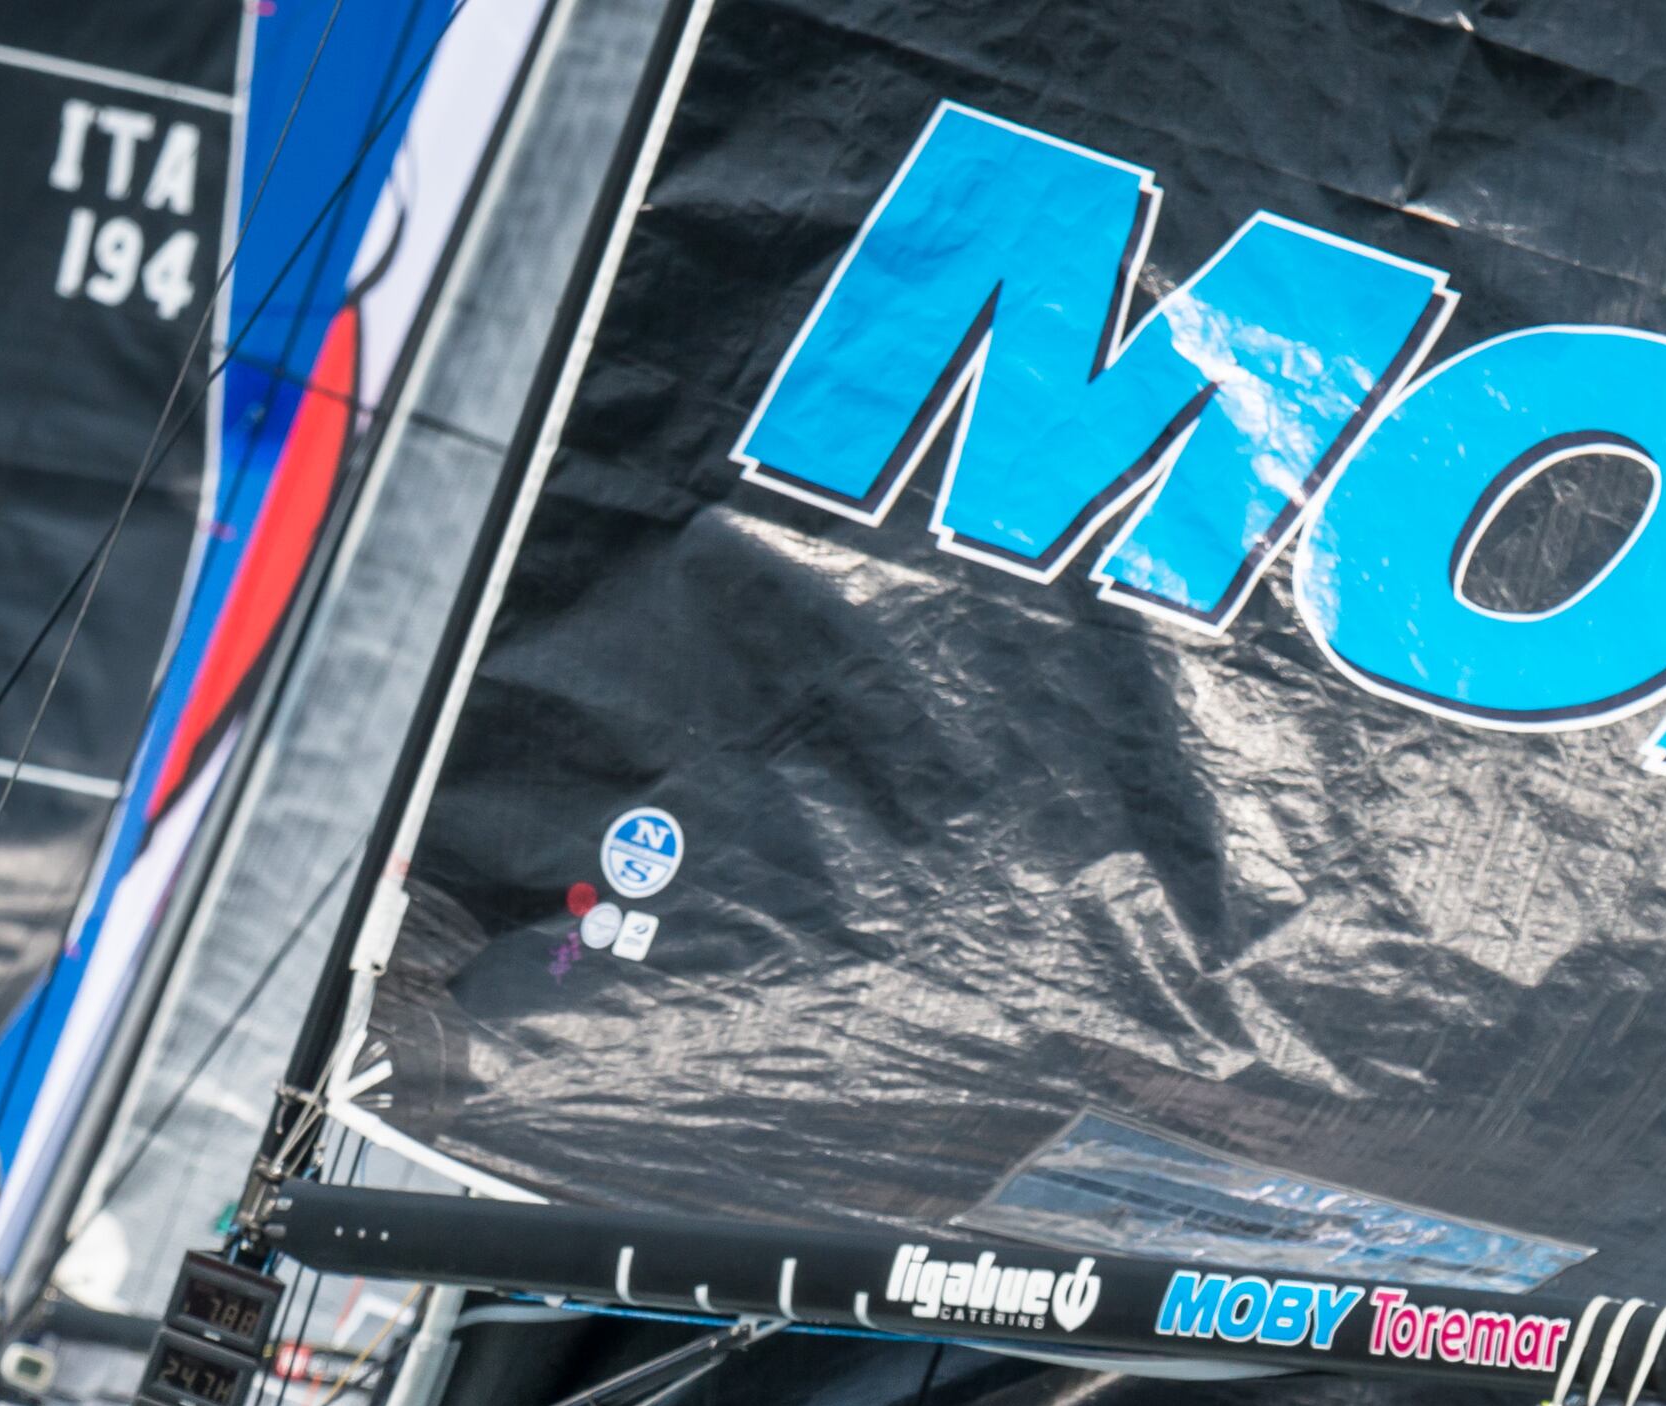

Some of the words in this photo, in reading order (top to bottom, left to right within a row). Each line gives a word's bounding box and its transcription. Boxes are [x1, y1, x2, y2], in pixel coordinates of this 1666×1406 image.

[48, 98, 201, 216] ITA
[54, 206, 199, 321] 194
[885, 1243, 1056, 1319] ligabue
[939, 1306, 1045, 1330] CATERING
[1154, 1270, 1366, 1350] MOBY
[1368, 1286, 1571, 1373] Toremar
